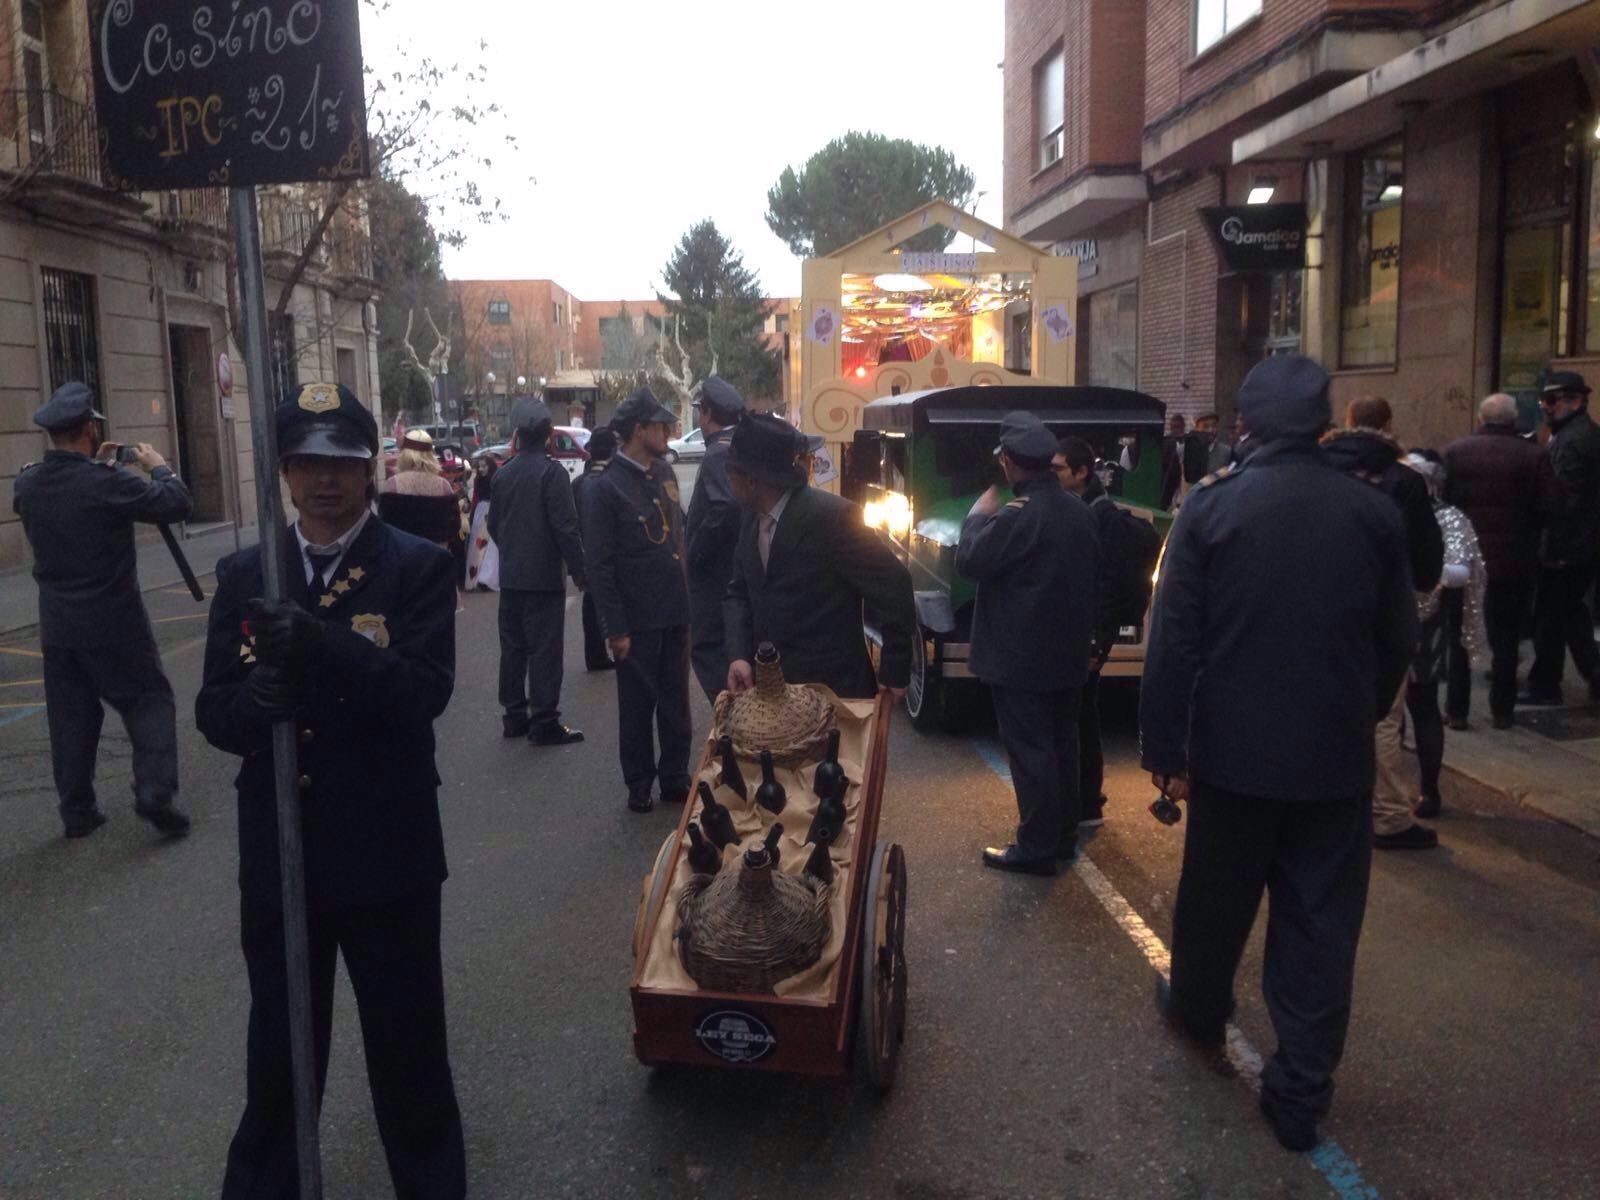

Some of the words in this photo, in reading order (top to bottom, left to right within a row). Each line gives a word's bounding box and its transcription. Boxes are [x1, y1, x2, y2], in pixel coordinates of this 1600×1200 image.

[101, 0, 322, 93] Casino
[156, 95, 224, 157] IPC
[1235, 229, 1300, 245] Jamaica
